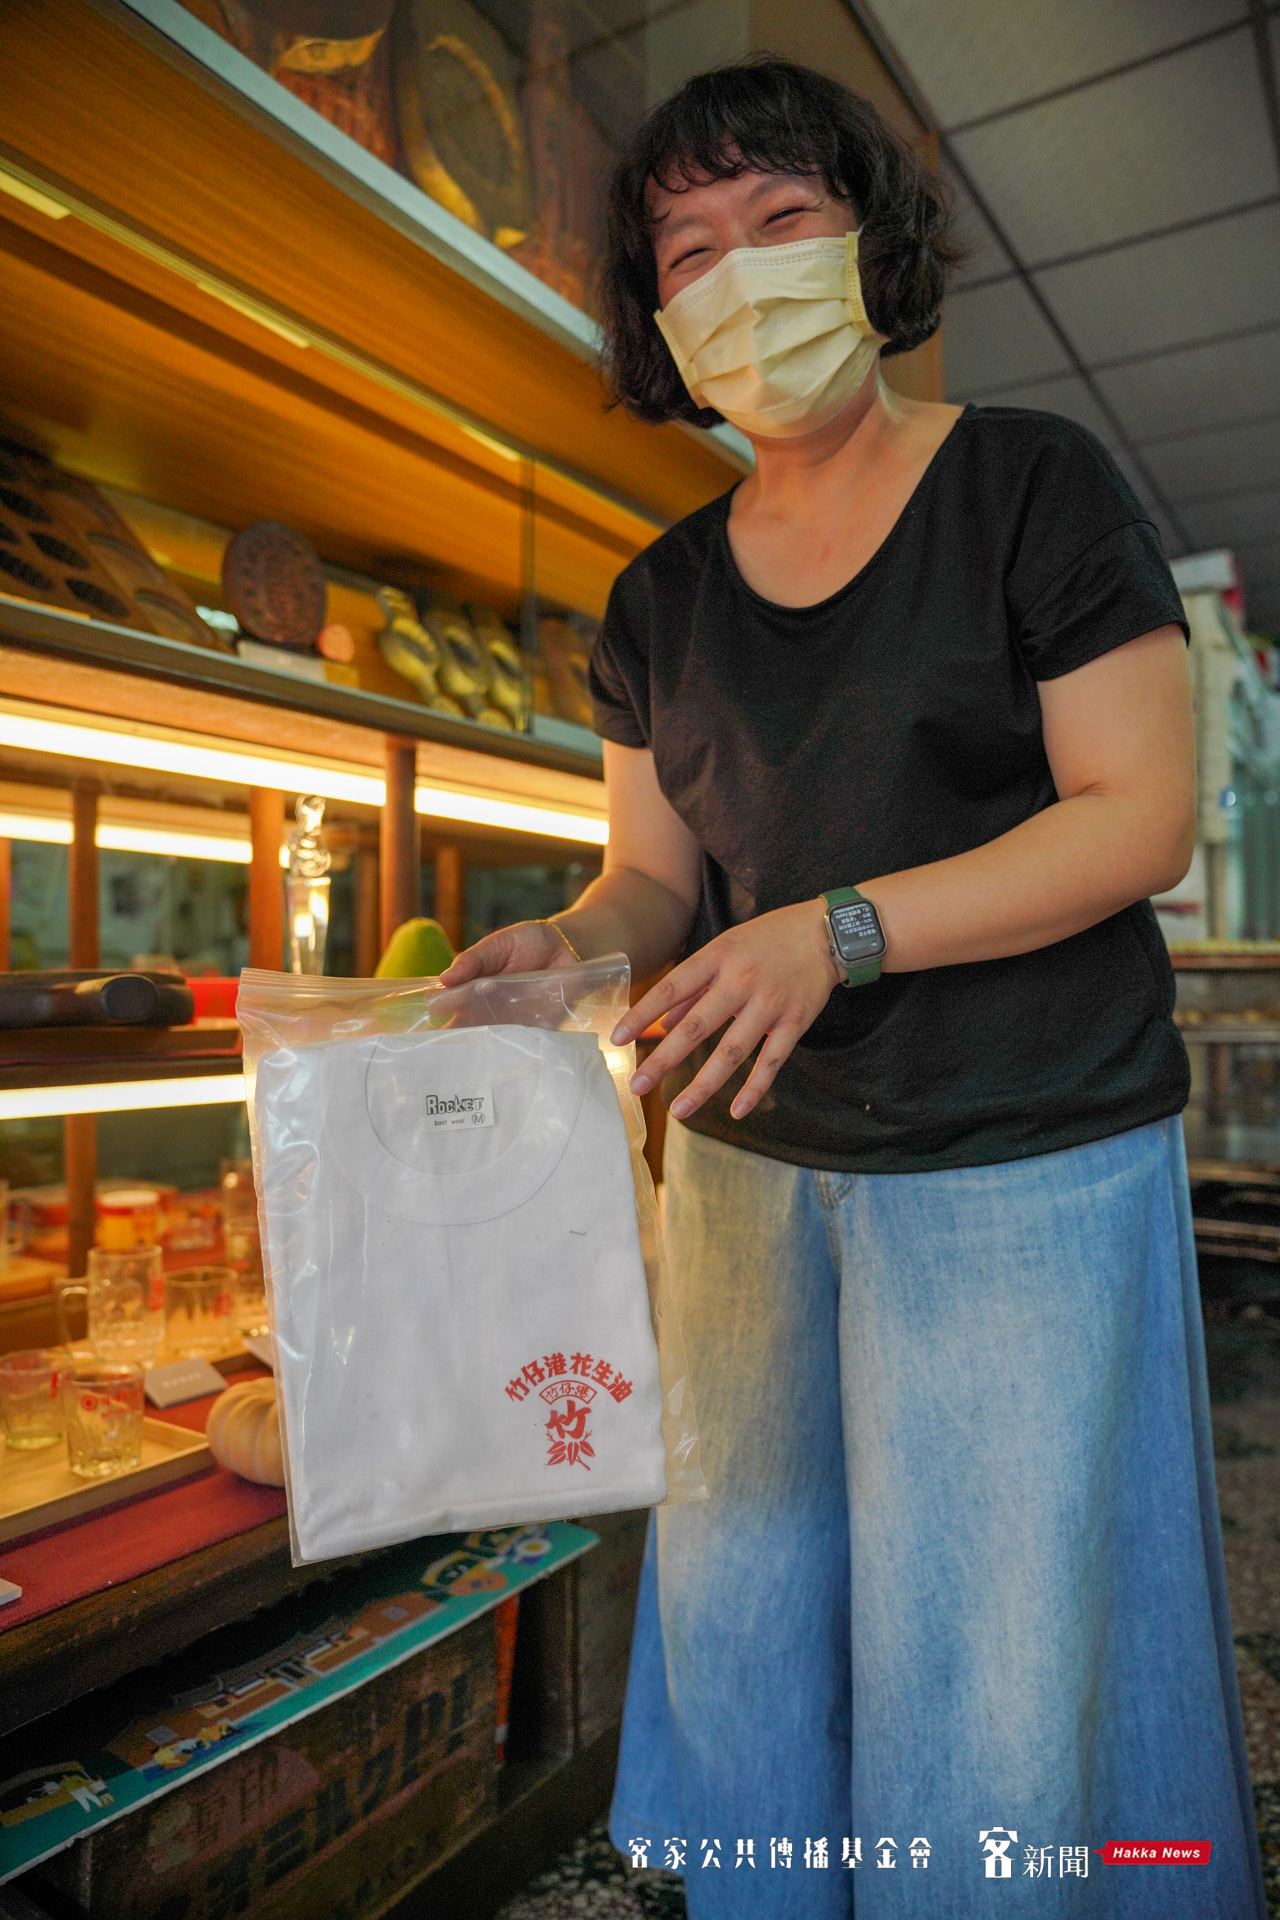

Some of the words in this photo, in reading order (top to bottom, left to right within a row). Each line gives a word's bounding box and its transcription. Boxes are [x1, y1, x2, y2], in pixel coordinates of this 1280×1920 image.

[504, 1352, 633, 1403] 竹仔港花生油
[544, 1399, 592, 1439] 竹
